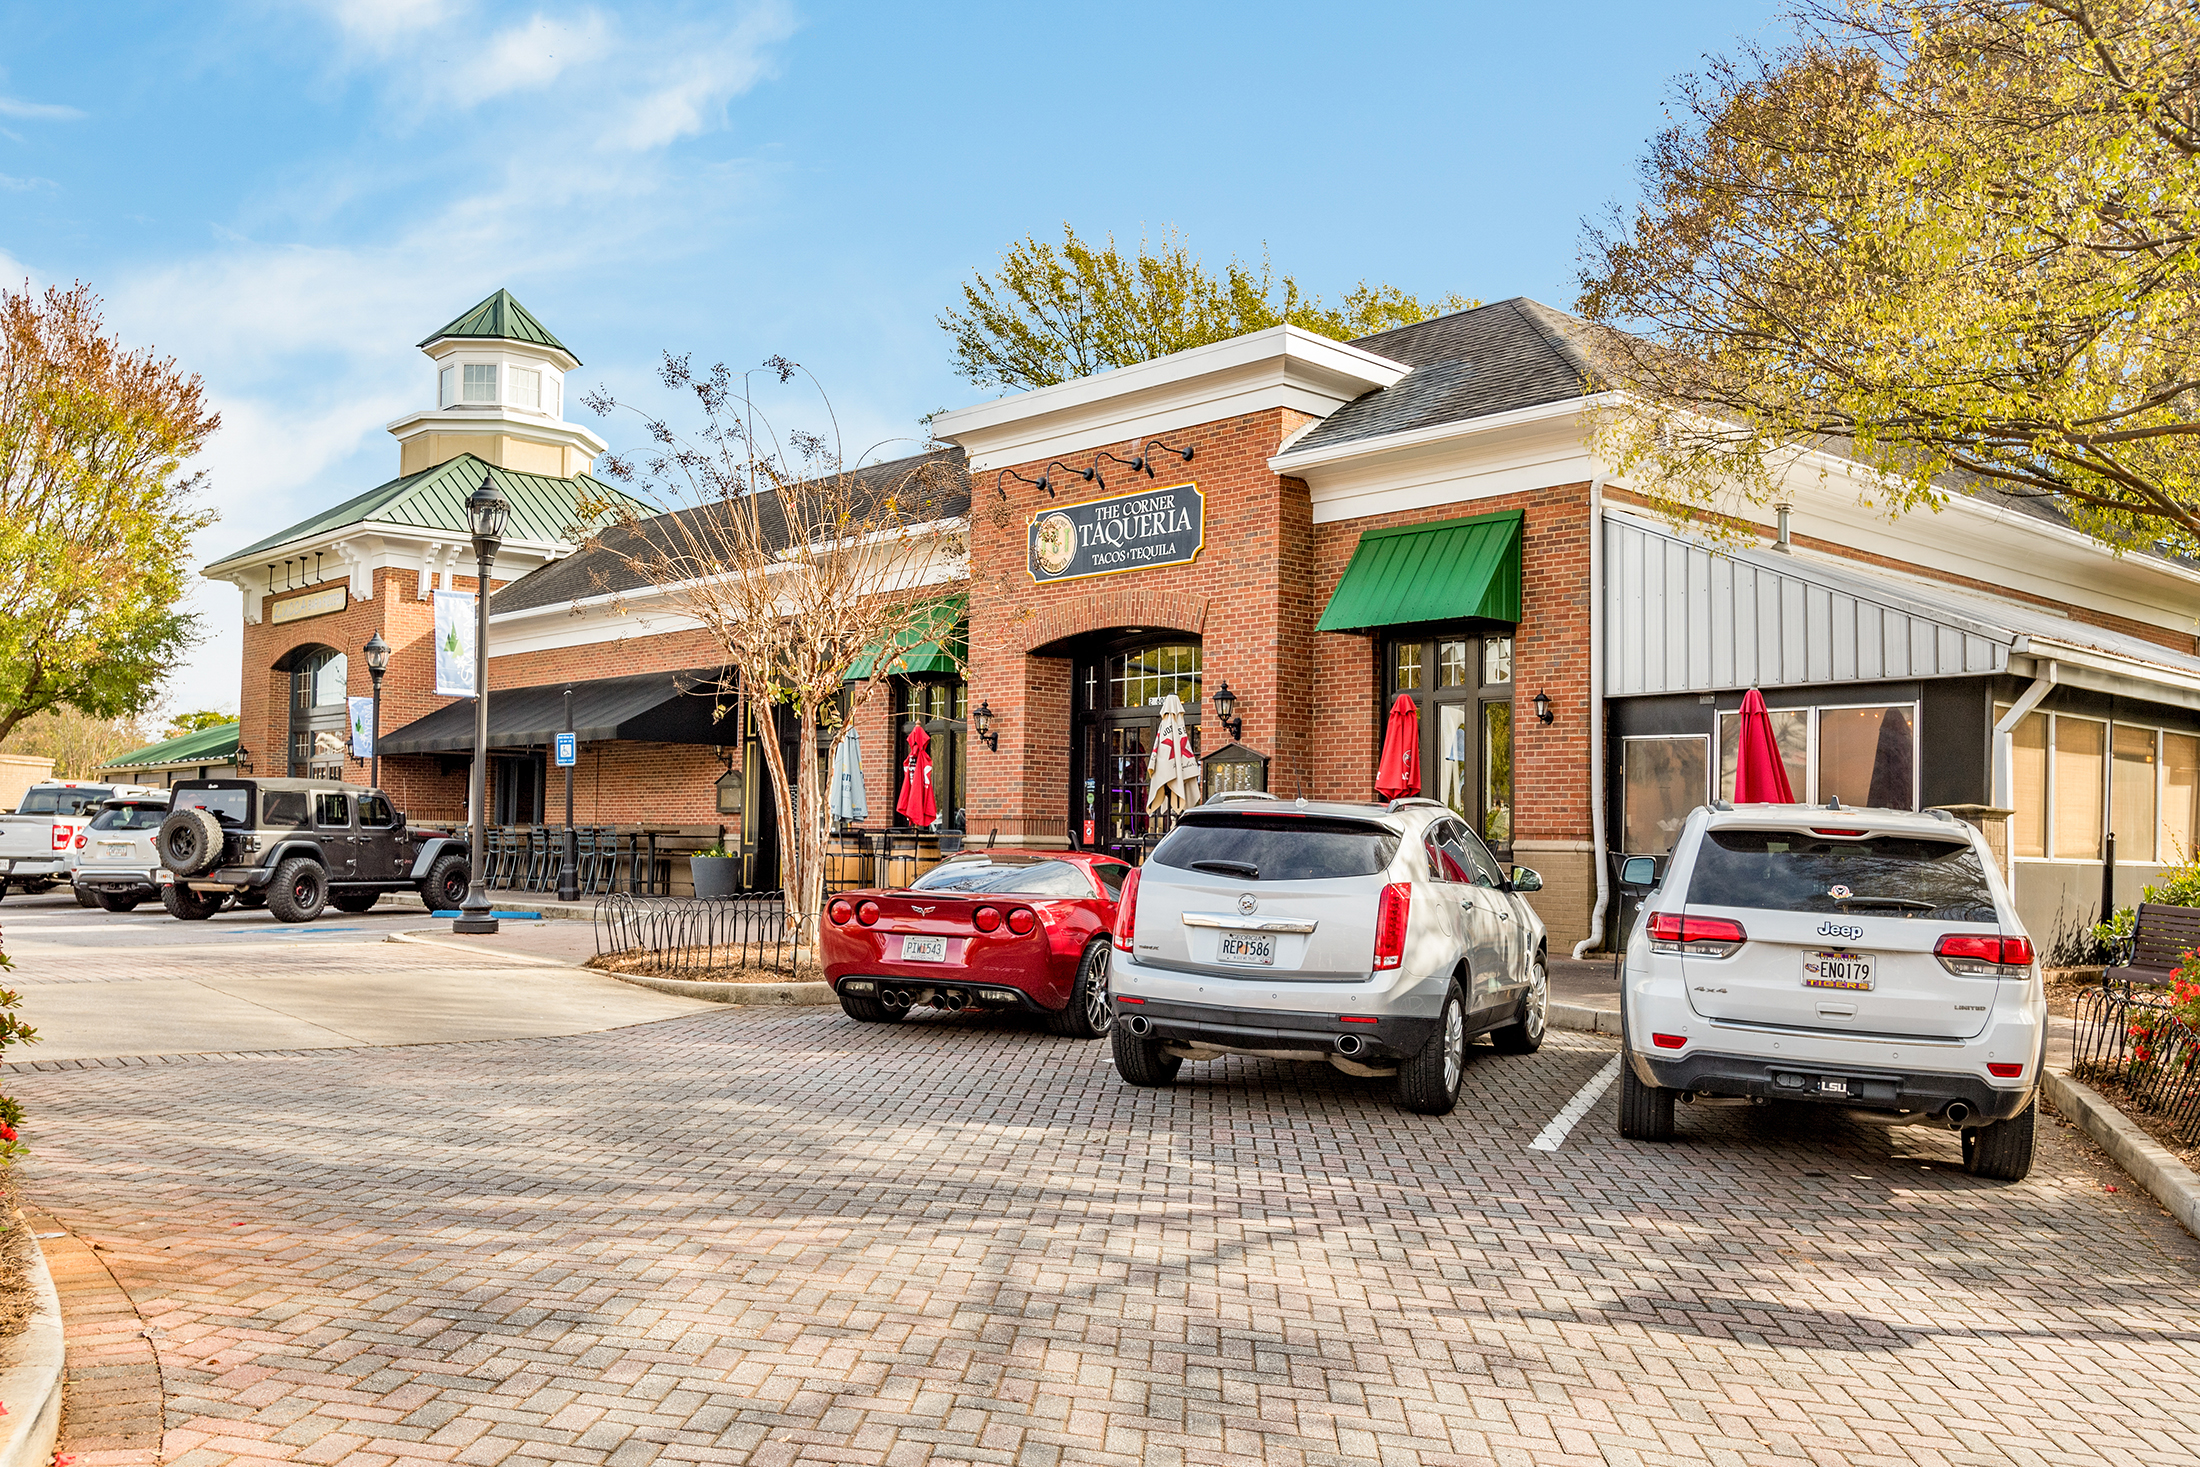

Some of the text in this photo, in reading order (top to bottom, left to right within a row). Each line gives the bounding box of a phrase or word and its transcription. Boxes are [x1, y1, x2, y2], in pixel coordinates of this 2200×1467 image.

[1095, 494, 1176, 521] THE CORNER
[1078, 506, 1193, 548] TAQUERIA
[1092, 542, 1177, 566] TACOS TEQUILA
[274, 598, 307, 619] ZUCCA
[1231, 933, 1262, 941] GEORGIA
[1817, 921, 1863, 940] Jeep
[1222, 939, 1270, 957] REP1586
[1820, 961, 1870, 980] ENQ179
[1807, 979, 1869, 990] TIGERS
[1821, 1081, 1847, 1093] LSU
